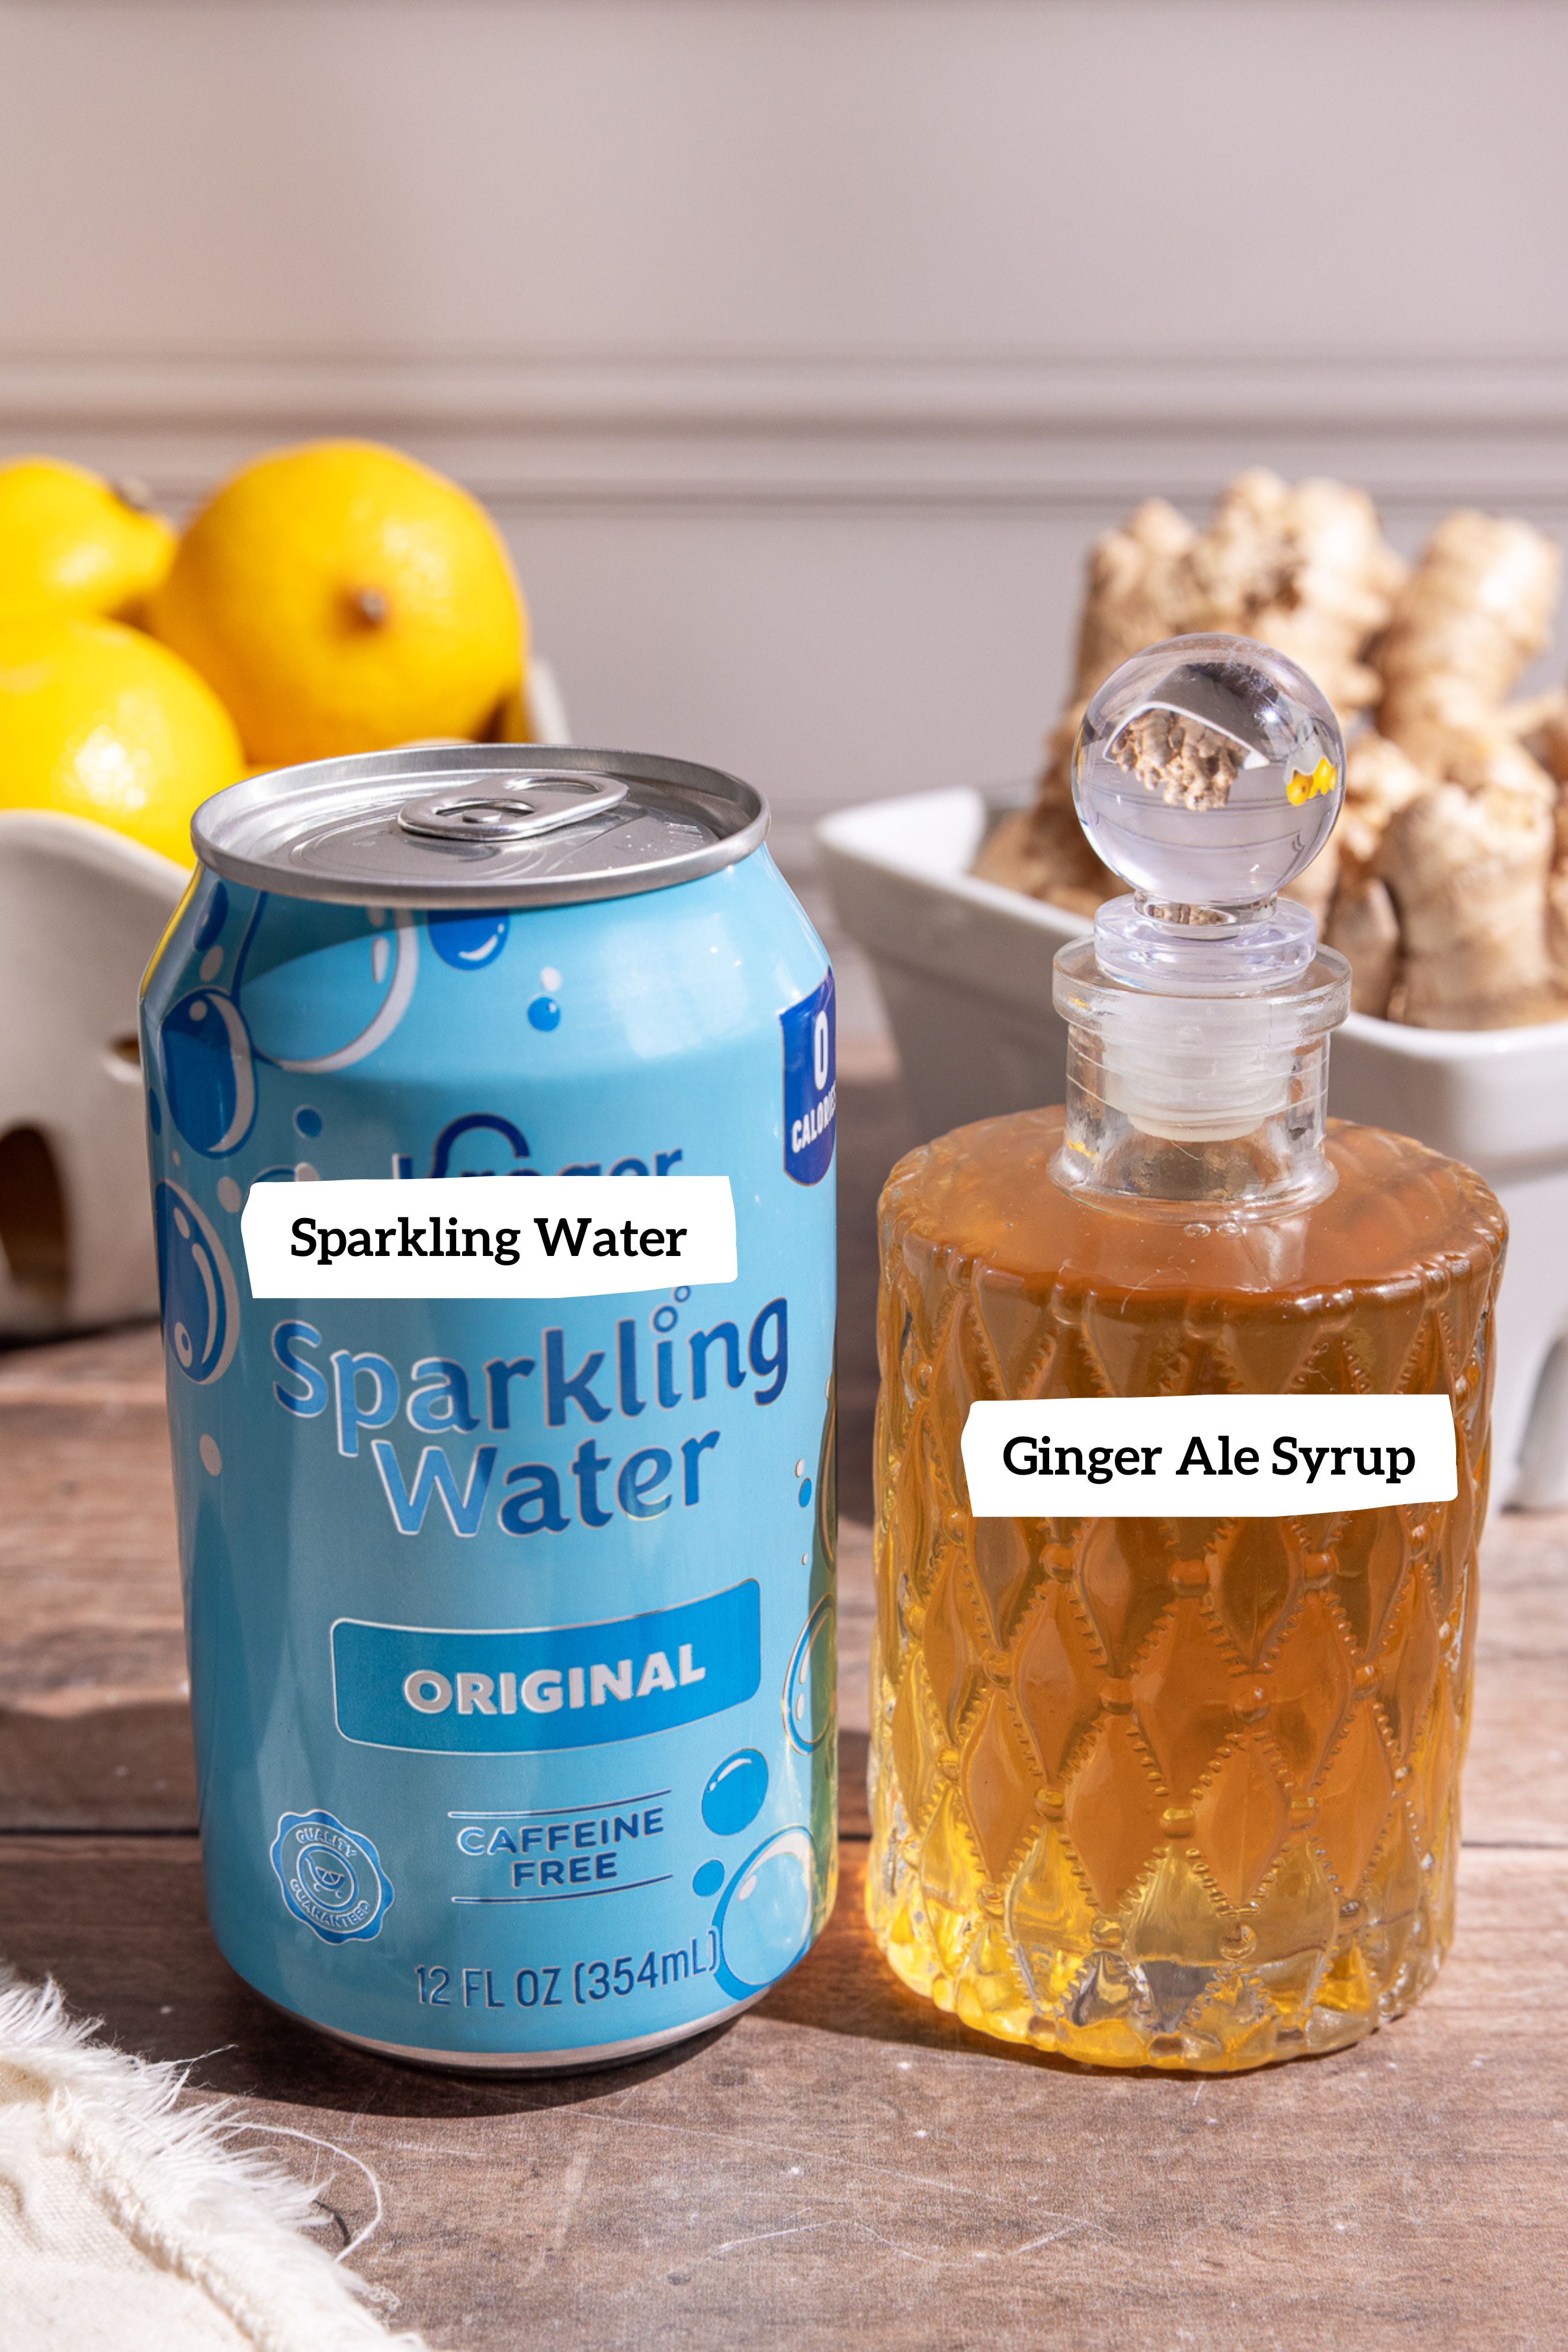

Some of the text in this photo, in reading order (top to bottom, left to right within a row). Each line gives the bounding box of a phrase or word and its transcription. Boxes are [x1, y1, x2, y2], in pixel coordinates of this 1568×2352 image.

[813, 1010, 829, 1091] 0
[791, 1079, 836, 1154] CALORIE
[271, 1296, 788, 1457] Sparkling
[371, 1430, 720, 1537] Water
[403, 1643, 707, 1715] ORIGINAL
[296, 1827, 358, 1858] QUALITY
[456, 1806, 664, 1856] CAFFEINE
[289, 1878, 370, 1928] GUARANTEED
[511, 1851, 618, 1889] FREE
[415, 1925, 720, 2008] 12 FL OZ (354mL)
